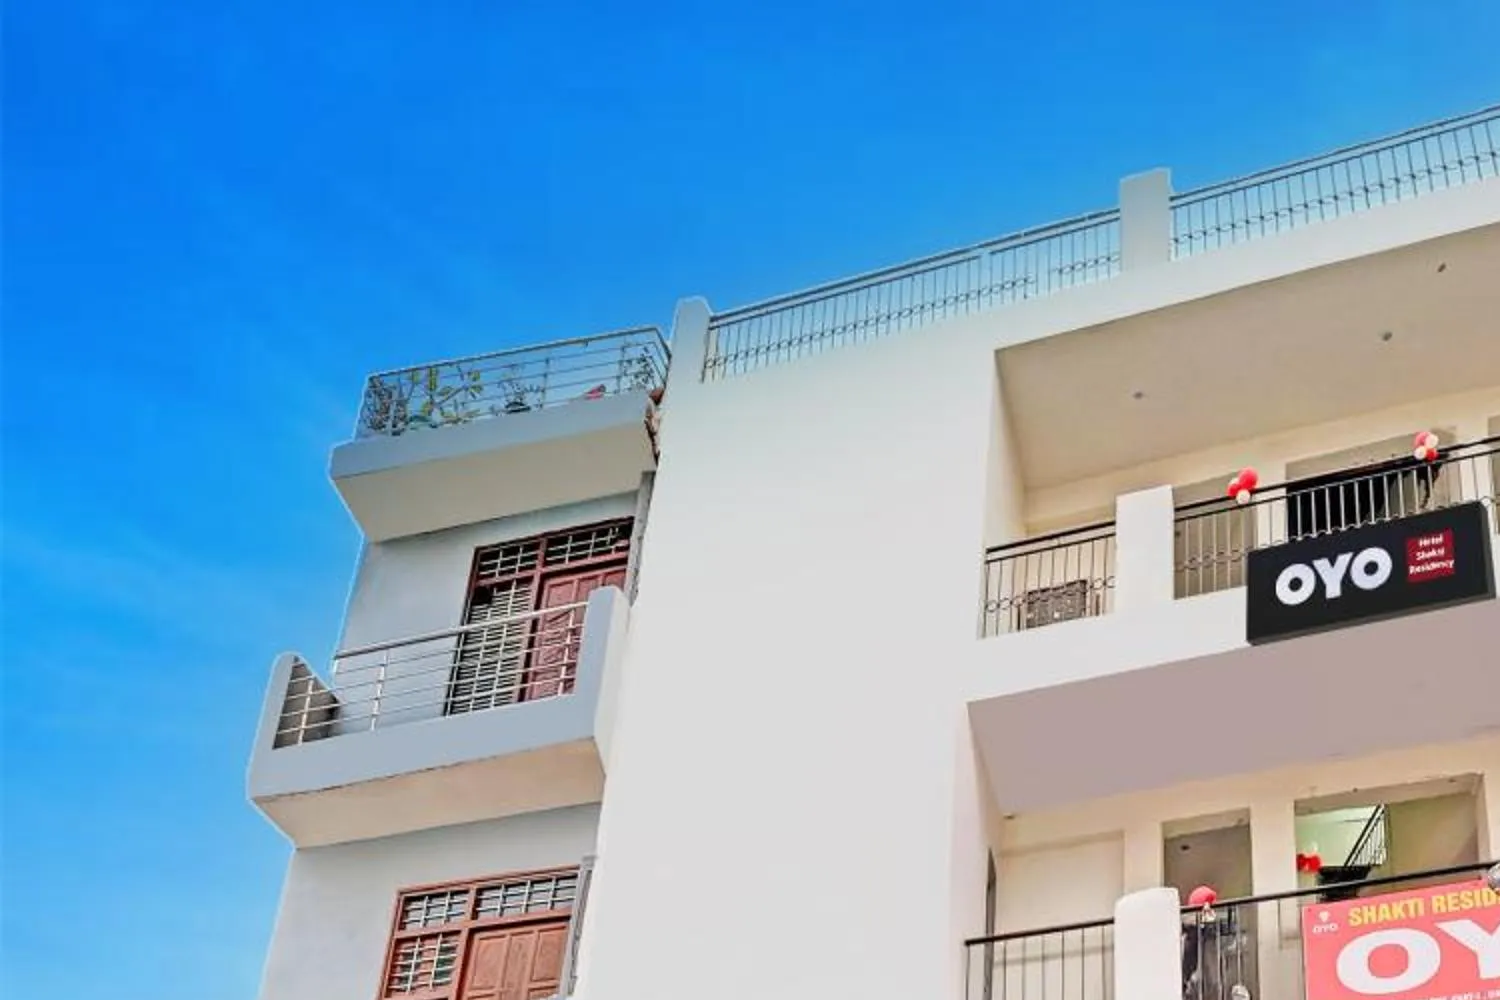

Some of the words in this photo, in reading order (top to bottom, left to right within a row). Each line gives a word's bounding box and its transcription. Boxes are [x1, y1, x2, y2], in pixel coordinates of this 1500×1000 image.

[1416, 547, 1445, 560] Shakti
[1409, 560, 1454, 575] Residency
[1275, 547, 1393, 606] OYO
[1348, 896, 1425, 927] SHAKTI
[1312, 922, 1339, 934] OYO
